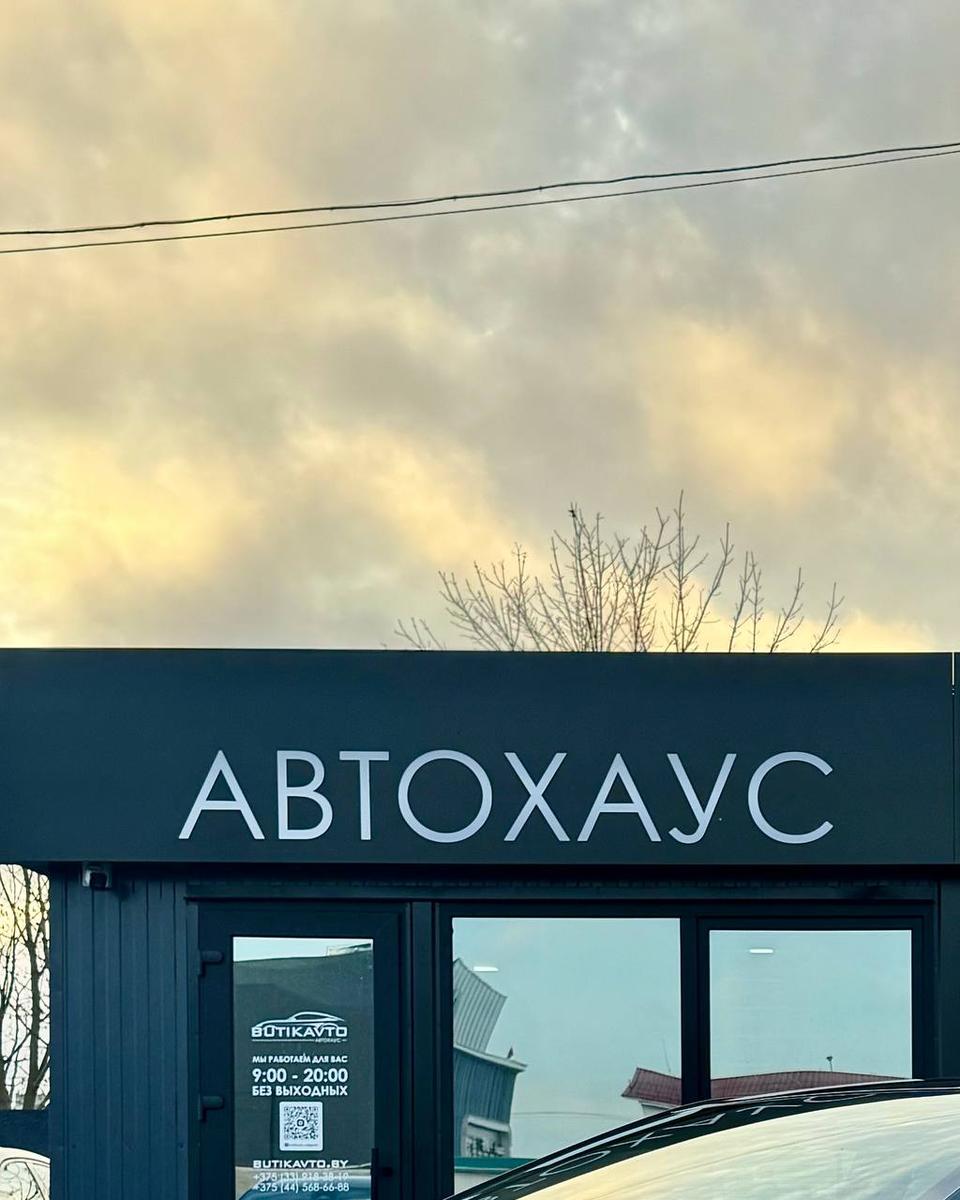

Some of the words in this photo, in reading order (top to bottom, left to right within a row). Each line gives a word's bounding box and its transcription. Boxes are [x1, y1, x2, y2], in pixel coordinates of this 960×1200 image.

[179, 750, 834, 844] АВТОХАУС
[251, 1026, 348, 1038] BUTIKAVTO
[252, 1055, 267, 1063] МЫ
[268, 1055, 311, 1063] РАБОТАЕМ
[312, 1055, 329, 1064] ДЛЯ
[330, 1055, 348, 1063] ВАС
[252, 1068, 287, 1083] 9:00
[303, 1068, 348, 1083] 20:00
[252, 1085, 272, 1096] БЕЗ
[275, 1085, 348, 1097] ВЫХОДНЫХ
[253, 1160, 349, 1168] BUTIKAVTO.BY
[253, 1182, 278, 1192] +375
[280, 1182, 299, 1194] (44)
[301, 1182, 350, 1192] 568-66-88
